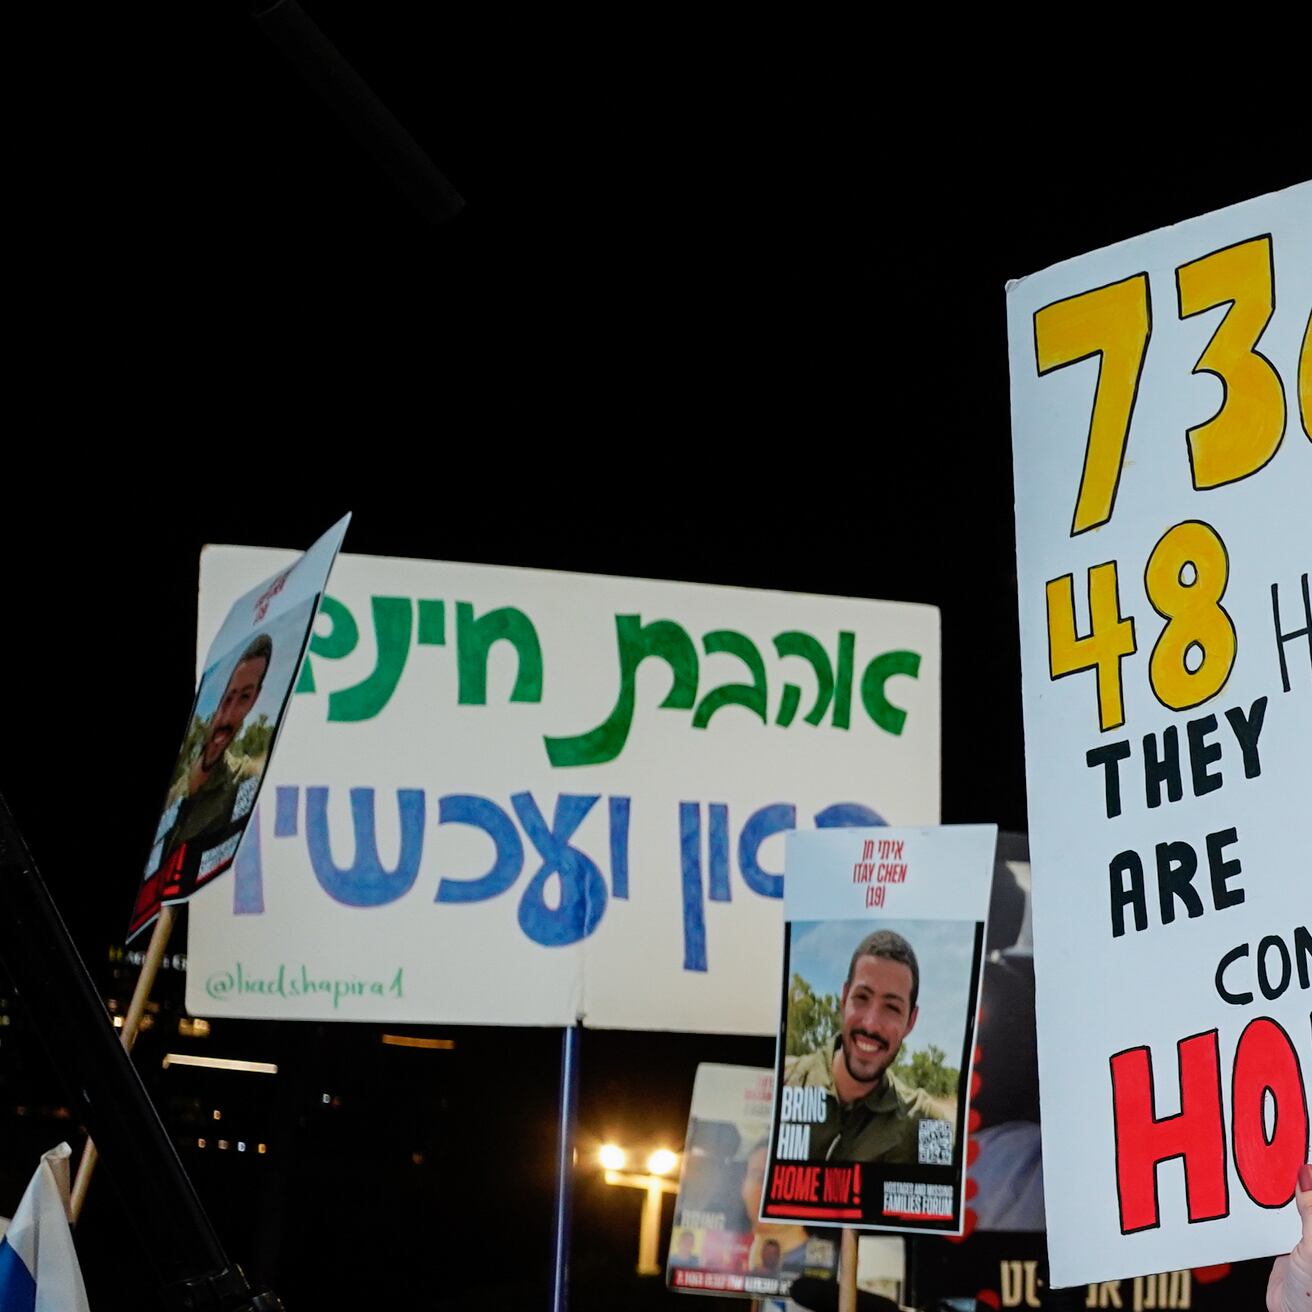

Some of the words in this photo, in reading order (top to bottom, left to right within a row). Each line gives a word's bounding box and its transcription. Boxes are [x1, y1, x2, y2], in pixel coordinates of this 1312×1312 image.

[1045, 519, 1238, 733] 48
[543, 610, 923, 766] אהבת
[1086, 696, 1268, 819] THEY
[862, 839, 874, 862] חן
[878, 839, 904, 861] איתי
[853, 863, 875, 884] ITAY
[877, 863, 907, 884] CHEN
[1109, 827, 1245, 938] ARE
[866, 885, 885, 909] (19)
[781, 1086, 827, 1123] BRING
[776, 1123, 811, 1161] HIM
[771, 1165, 821, 1203] HOME
[883, 1193, 921, 1213] FAMILIES
[922, 1195, 953, 1216] FORUM
